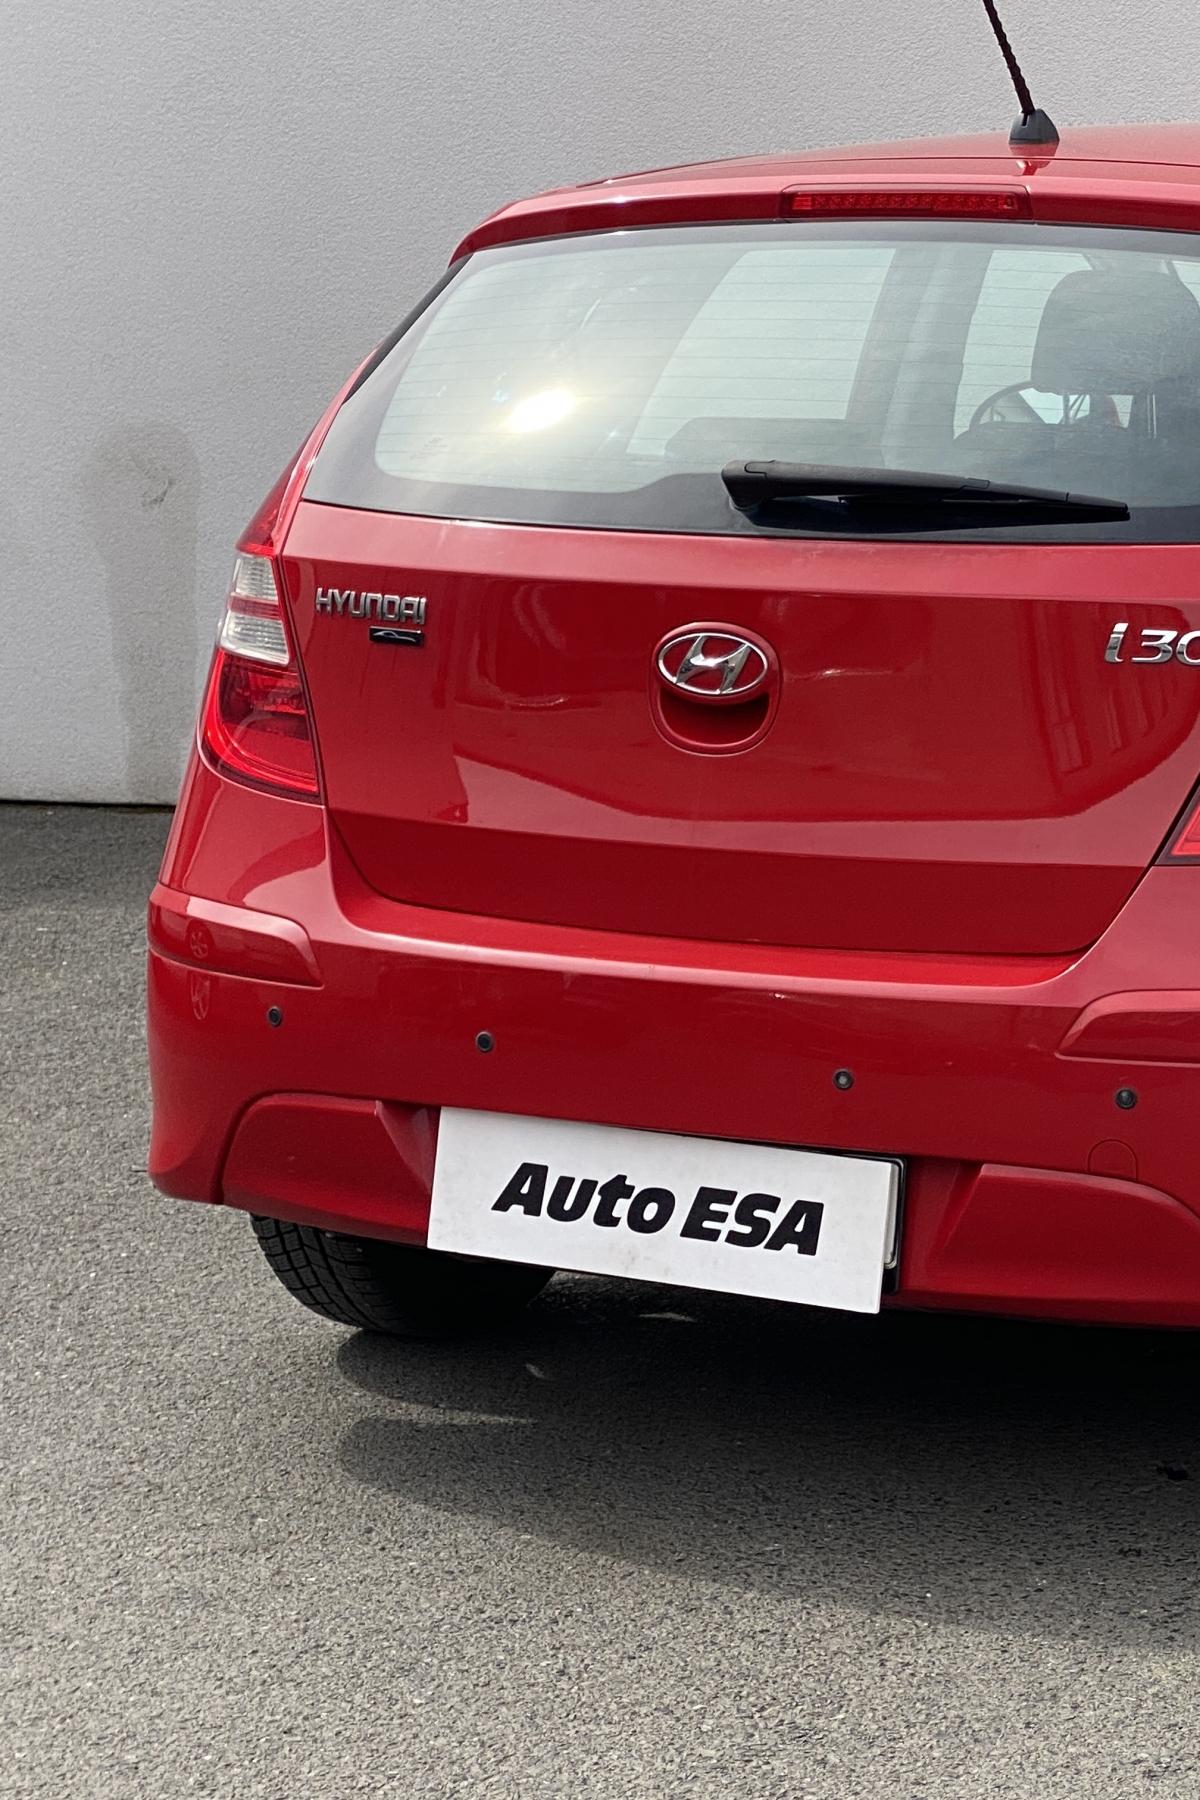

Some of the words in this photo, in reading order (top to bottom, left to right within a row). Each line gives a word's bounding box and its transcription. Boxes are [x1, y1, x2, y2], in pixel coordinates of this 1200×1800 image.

[315, 587, 426, 624] HYUNDAI
[491, 1162, 676, 1234] Auto
[679, 1186, 825, 1256] ESA
